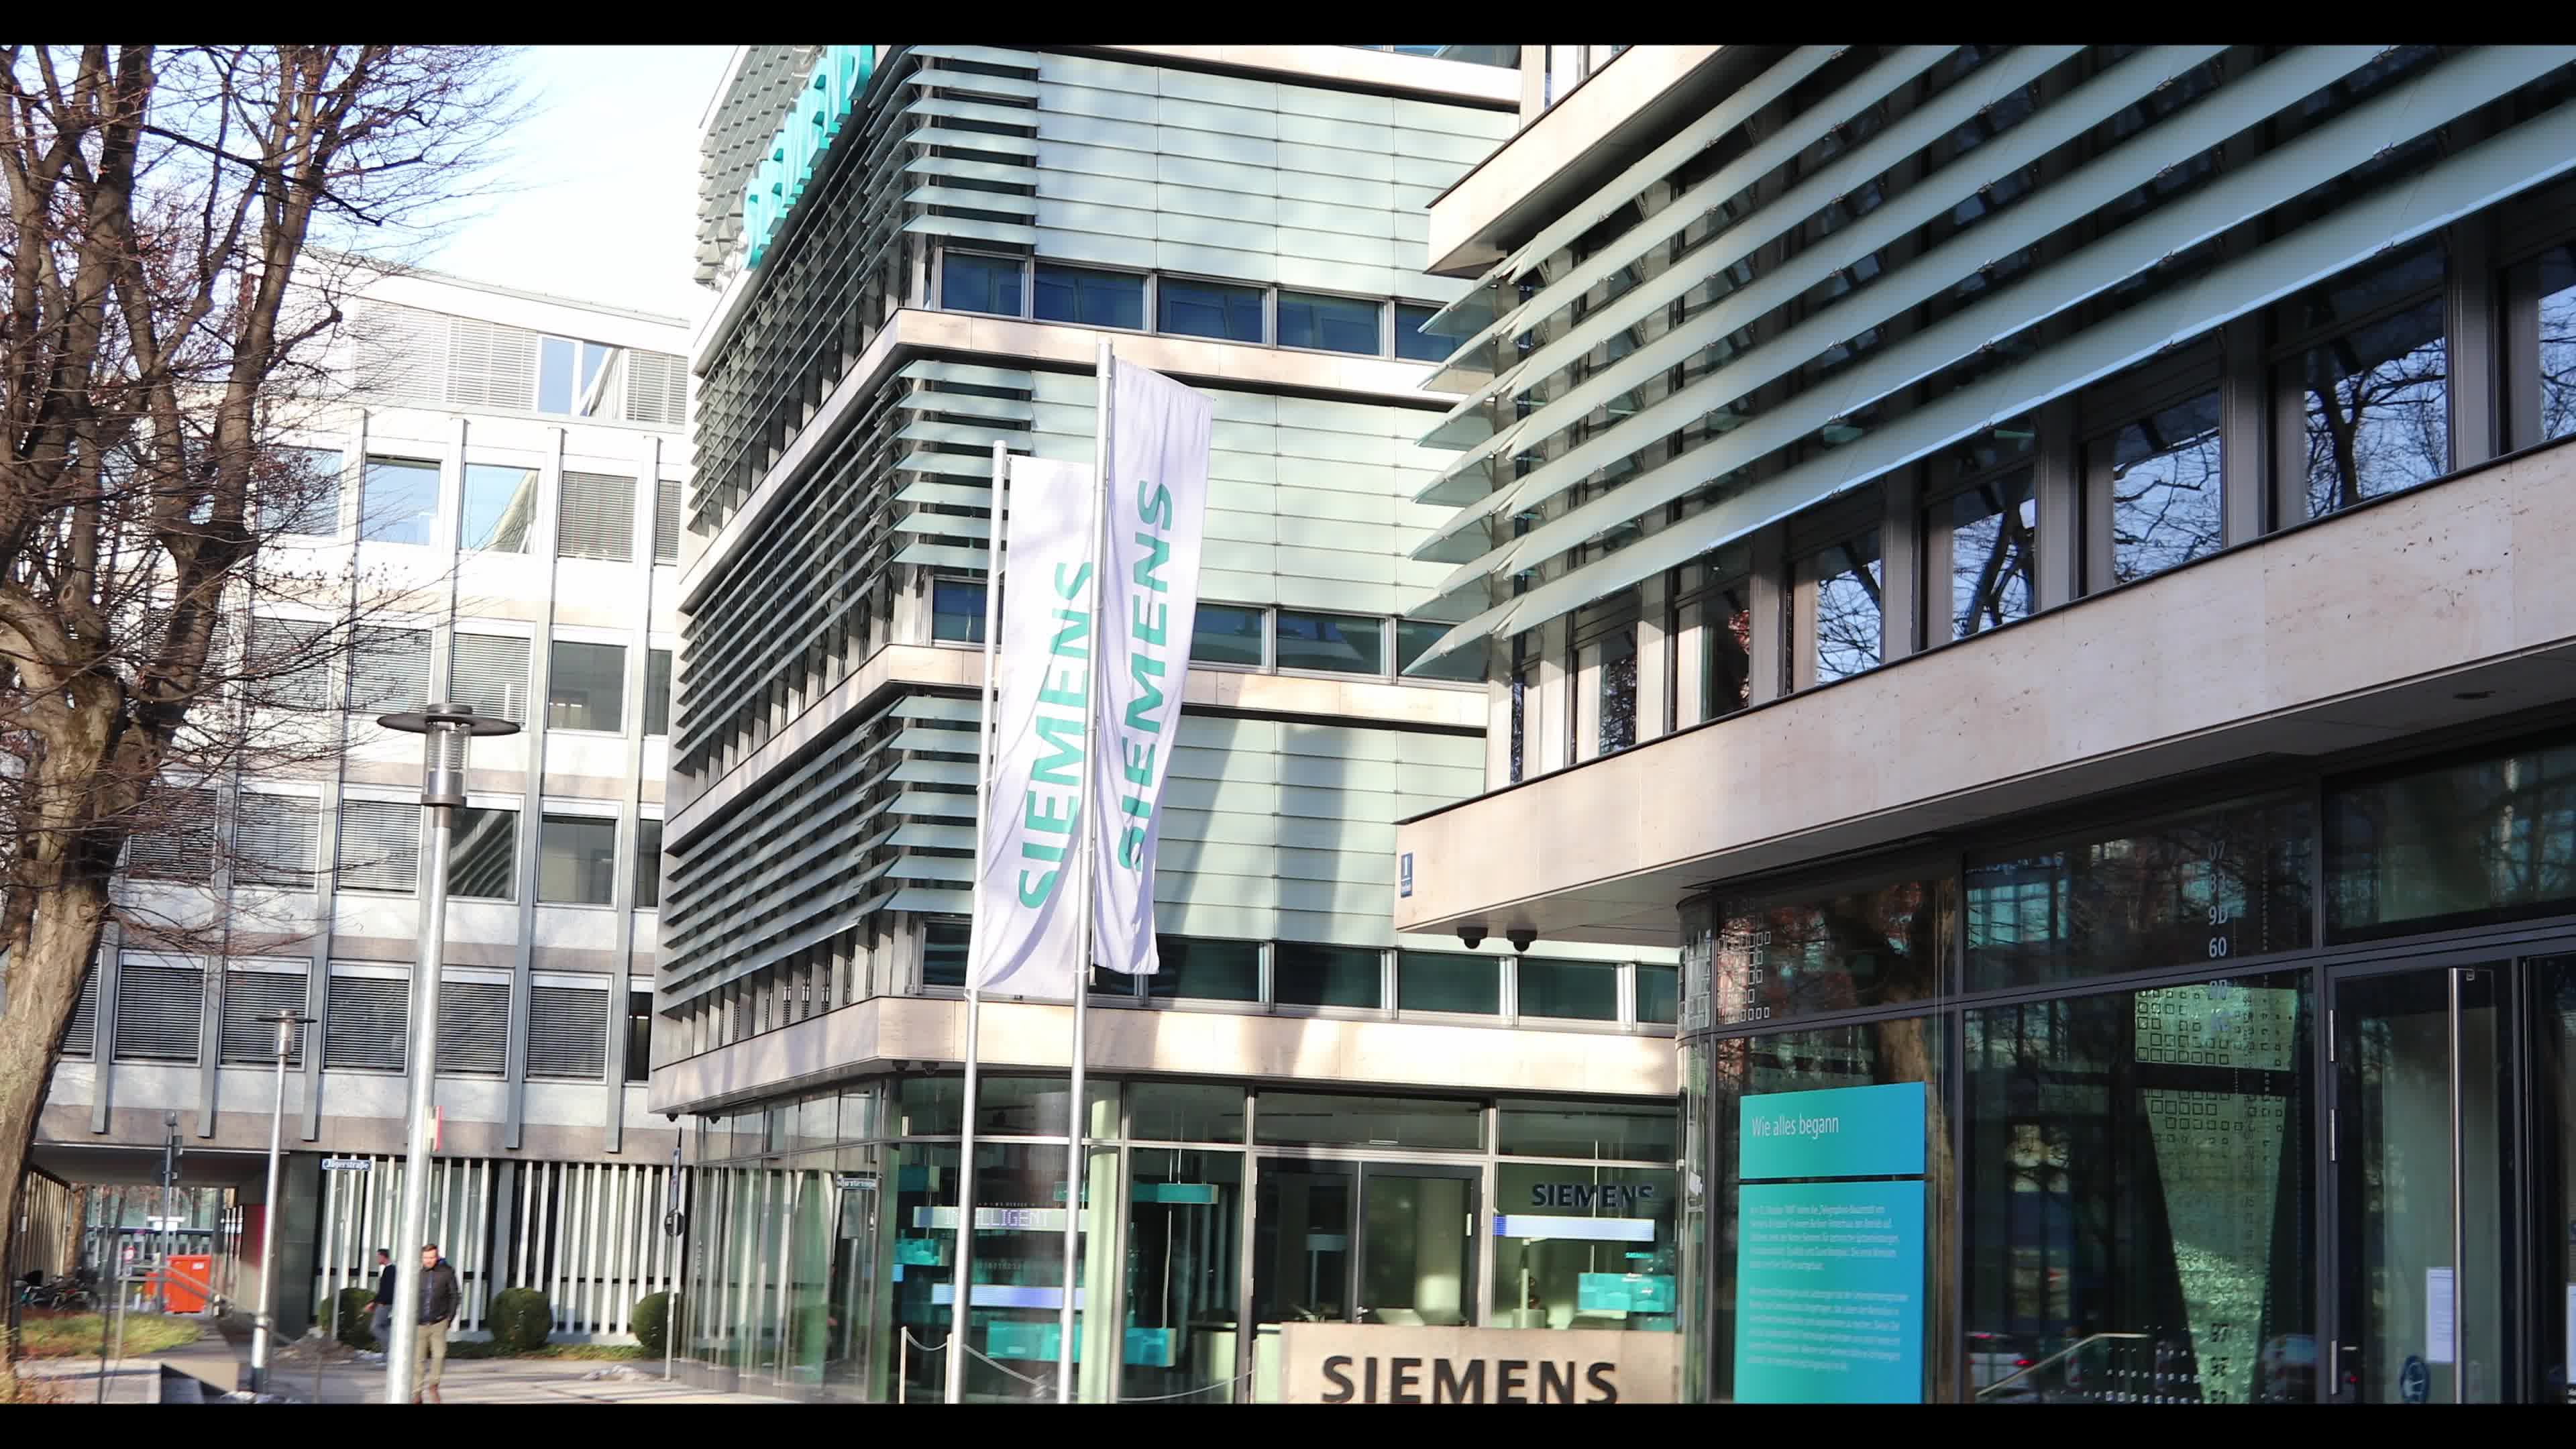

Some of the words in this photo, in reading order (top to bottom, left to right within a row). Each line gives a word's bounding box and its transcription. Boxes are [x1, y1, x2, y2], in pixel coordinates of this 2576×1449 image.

[1118, 480, 1173, 871] SIEMENS
[1018, 561, 1091, 910] SIEMENS
[2209, 936, 2227, 957] 60
[1752, 1116, 1771, 1136] Wie
[1773, 1114, 1796, 1136] alles
[1799, 1113, 1839, 1139] begann
[1322, 1356, 1618, 1403] SIEMENS
